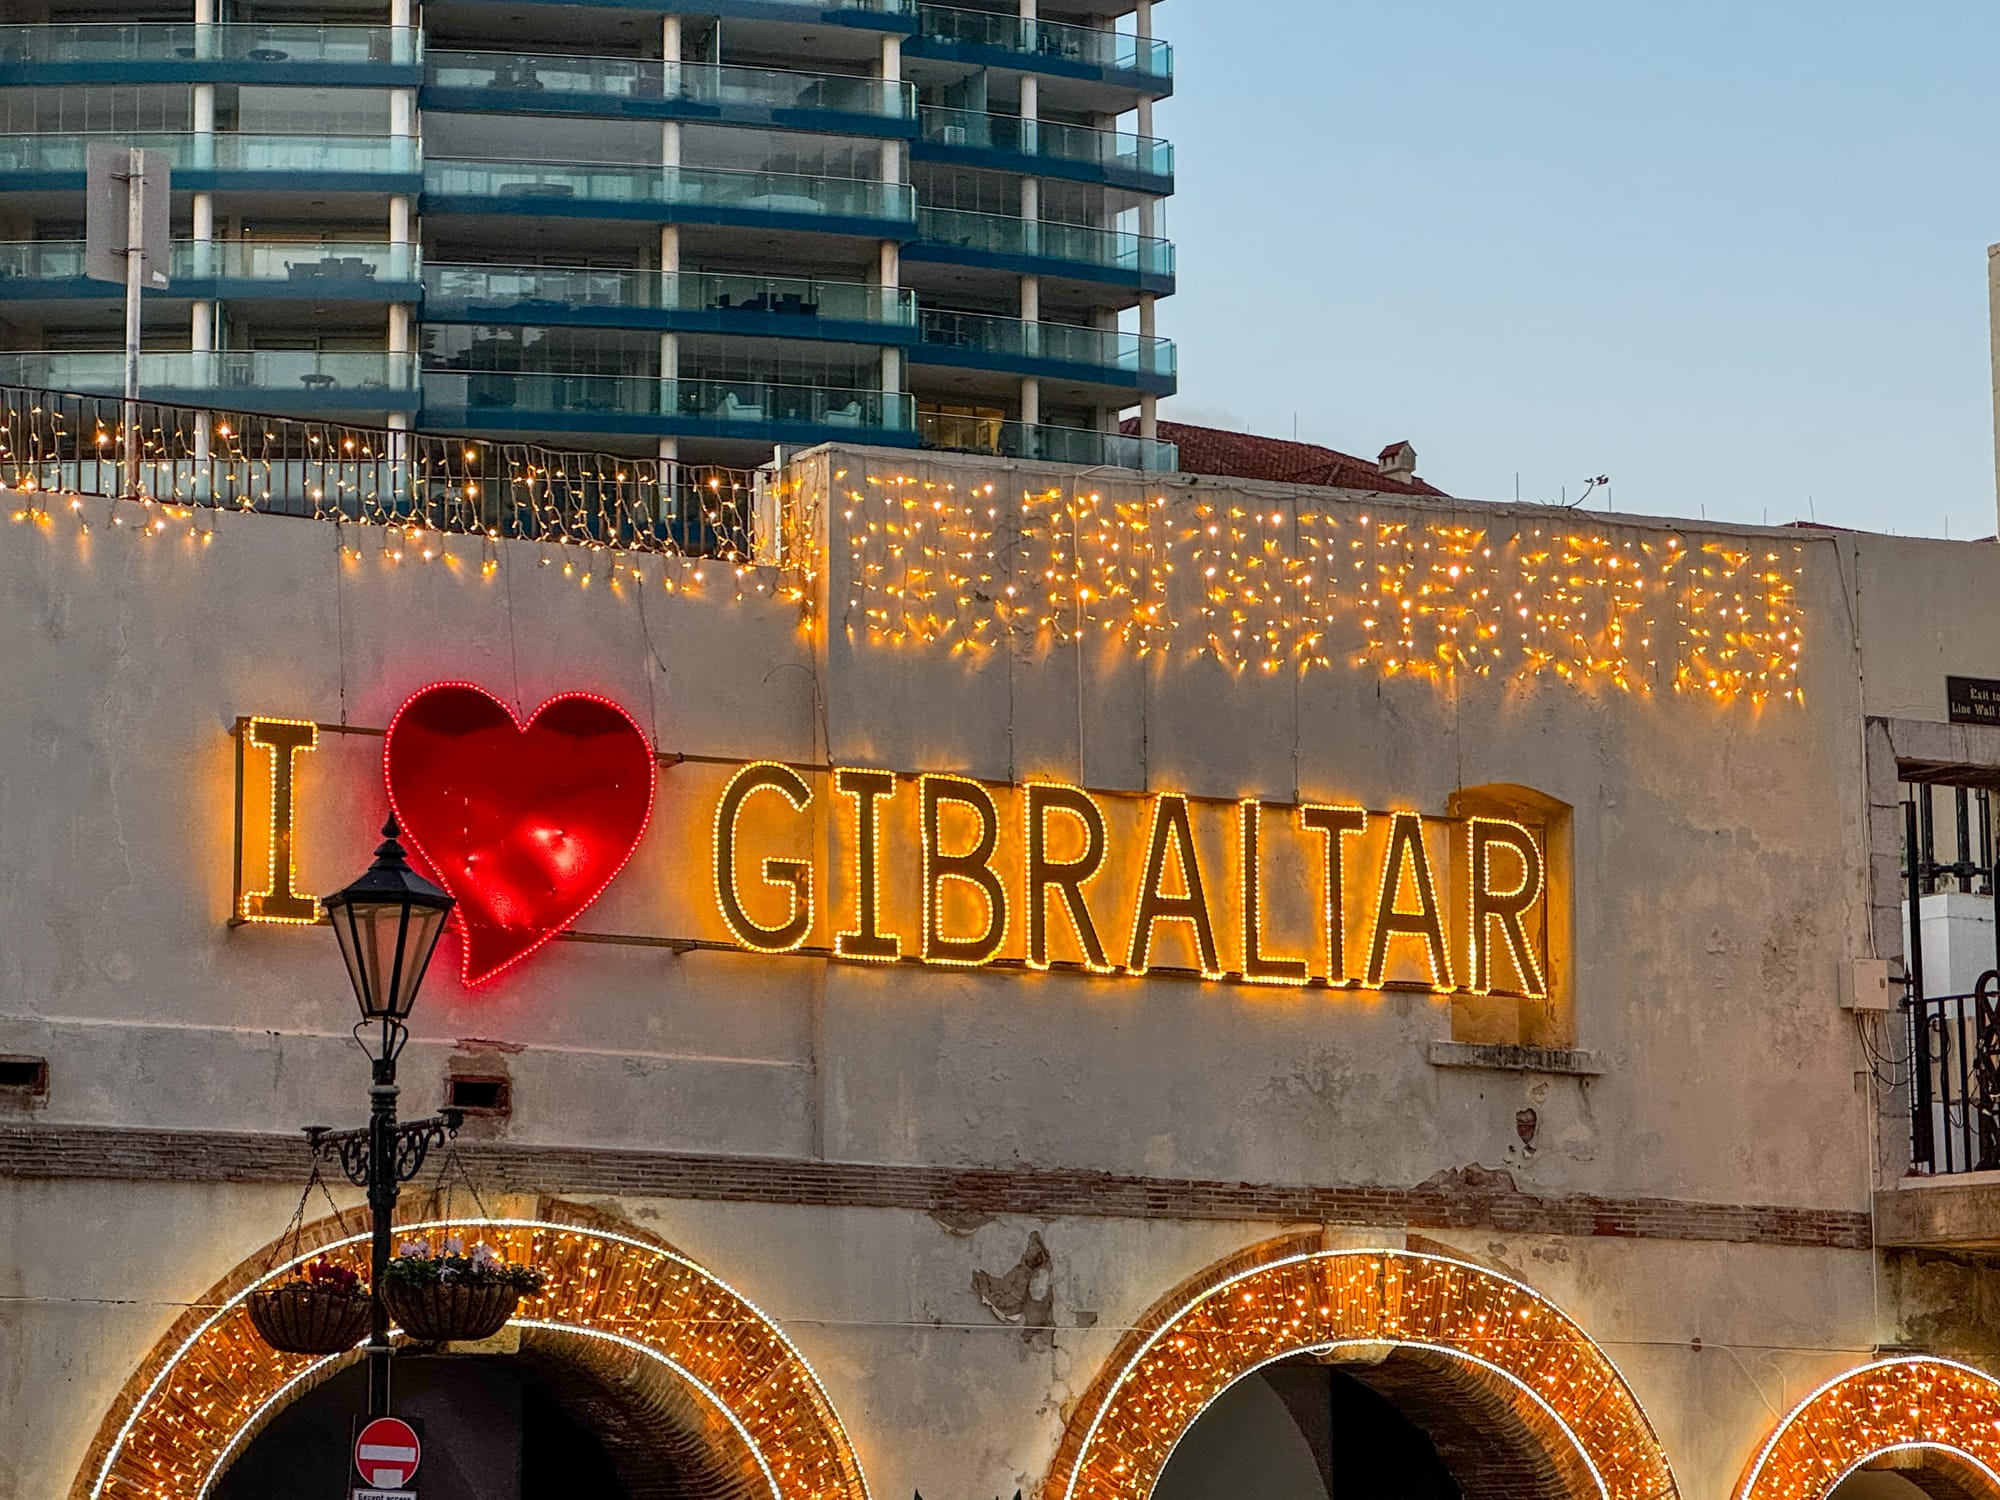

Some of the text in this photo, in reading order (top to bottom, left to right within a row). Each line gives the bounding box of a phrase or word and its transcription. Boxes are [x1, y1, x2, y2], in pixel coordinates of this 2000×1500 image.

[1970, 687, 1989, 700] Exit
[1951, 701, 1971, 714] Line
[1974, 703, 1995, 717] Wall
[241, 716, 1548, 999] I GIBRALTAR
